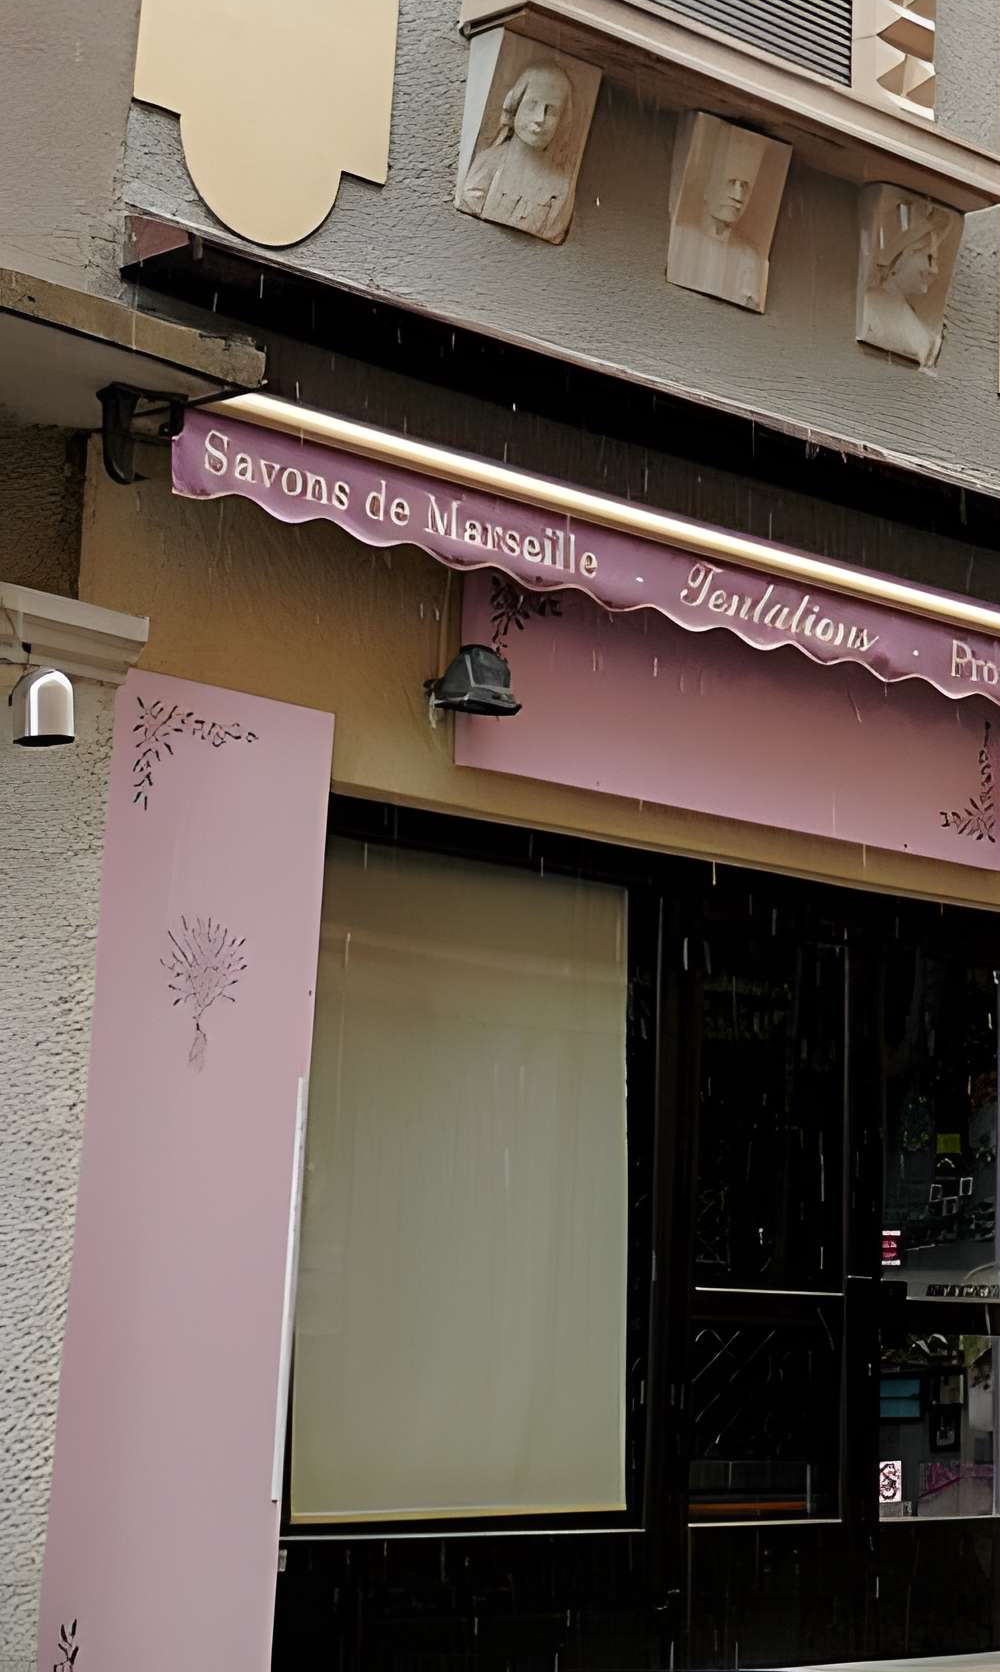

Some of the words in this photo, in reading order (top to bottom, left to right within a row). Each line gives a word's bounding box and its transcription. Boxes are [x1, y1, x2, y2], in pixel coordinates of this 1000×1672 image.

[204, 429, 351, 510] Savons
[365, 480, 410, 526] de
[424, 493, 599, 578] Marseille
[680, 561, 879, 652] Tentations
